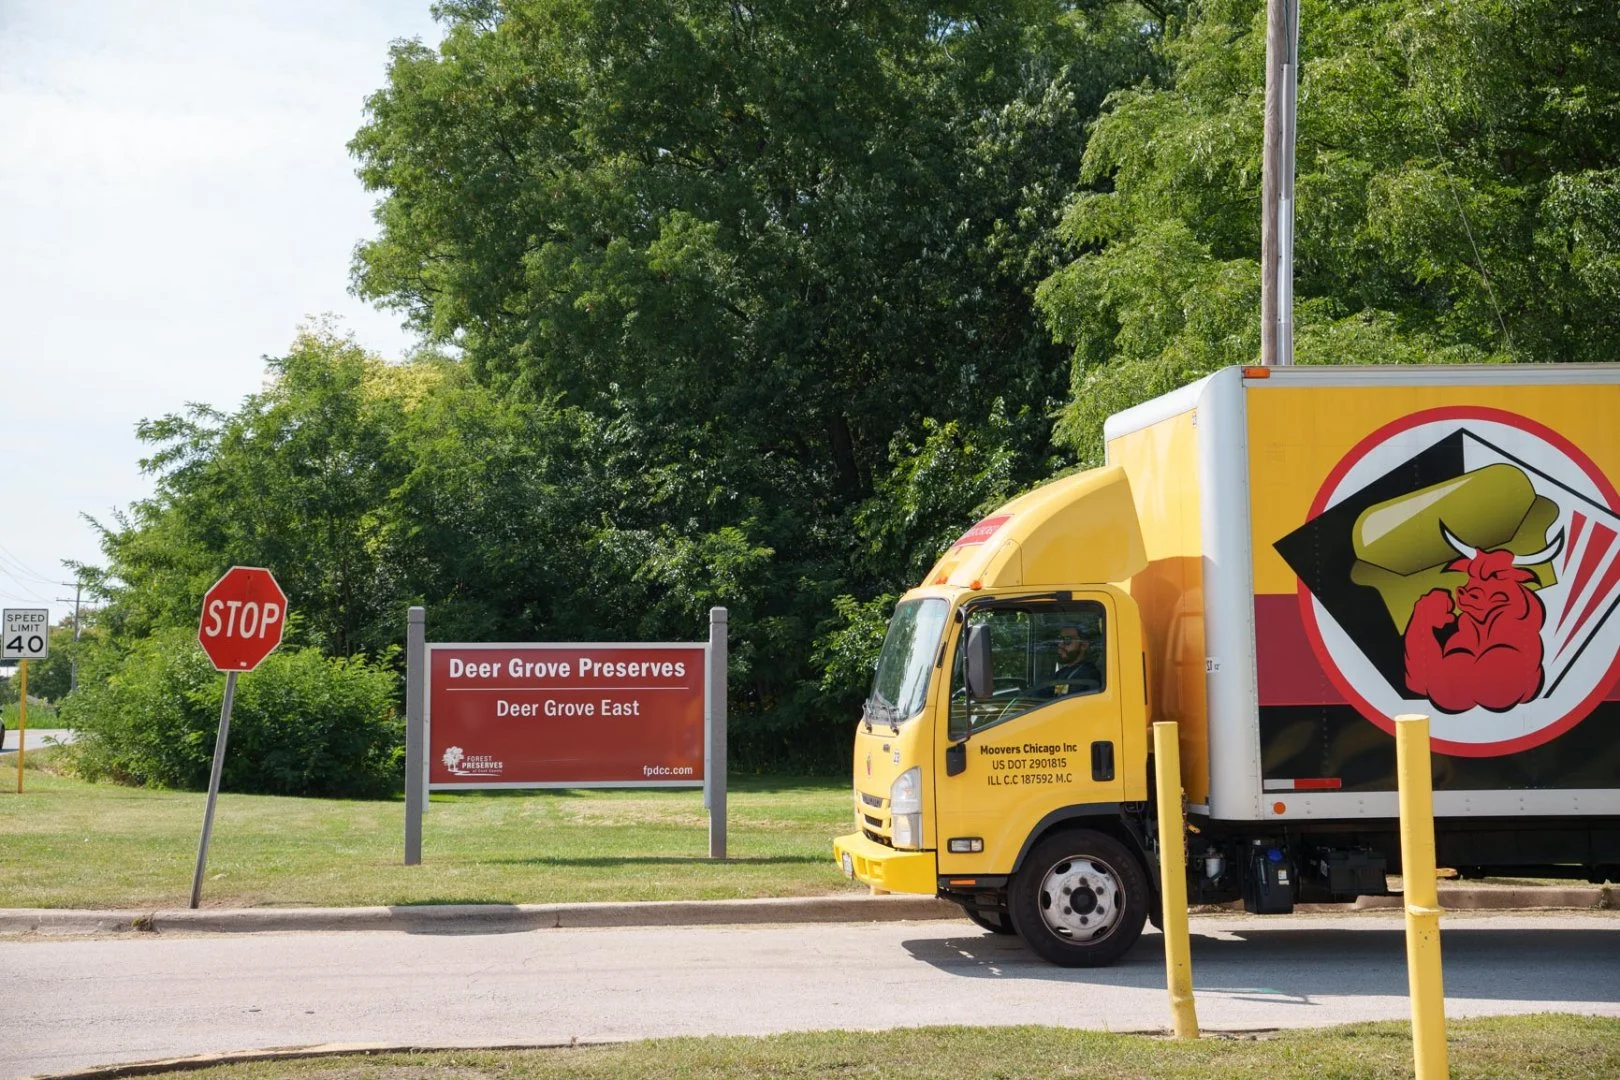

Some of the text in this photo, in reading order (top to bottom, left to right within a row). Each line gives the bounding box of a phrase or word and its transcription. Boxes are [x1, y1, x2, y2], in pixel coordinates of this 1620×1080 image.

[7, 613, 45, 623] SPEED
[204, 599, 280, 639] STOP
[10, 624, 40, 632] LIMIT
[6, 635, 44, 654] 40
[449, 657, 686, 678] Deer Grove Preserves
[496, 699, 640, 717] Deer Grove East
[980, 743, 1078, 755] Moovers Chicago Inc
[462, 761, 504, 769] PRESERVES
[992, 758, 1067, 770] US DOT 2901815
[643, 765, 693, 777] fpdcc.com
[987, 772, 1073, 786] ILL C.C 187592 M.C
